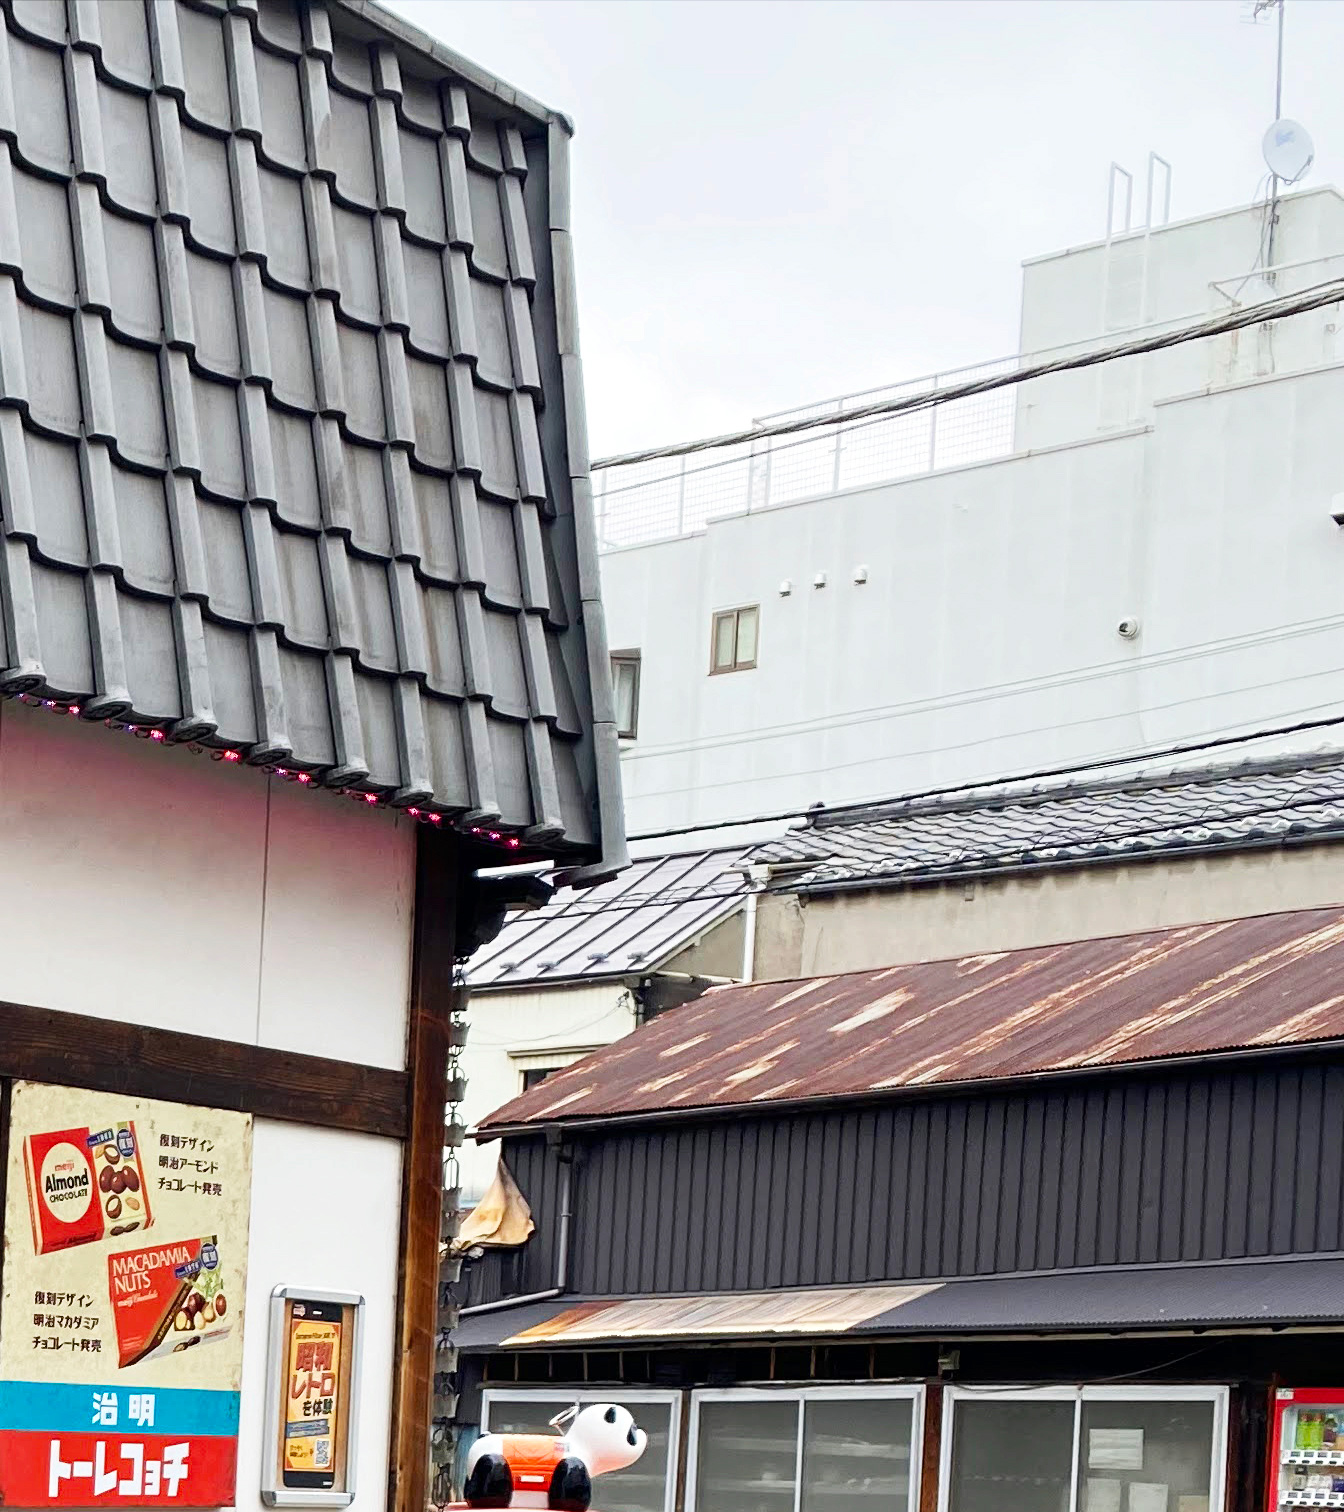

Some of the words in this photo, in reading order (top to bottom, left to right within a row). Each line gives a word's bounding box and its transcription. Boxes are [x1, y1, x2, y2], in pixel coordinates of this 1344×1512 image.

[159, 1155, 218, 1174] 明治アーモンド
[45, 1168, 89, 1193] Almond
[158, 1177, 222, 1196] チョコレート発売
[113, 1246, 192, 1277] MACADAMIA
[114, 1271, 151, 1295] NUTS
[35, 1291, 94, 1307] 復刻デザイン
[33, 1314, 100, 1330] 明治マカダミア
[32, 1336, 102, 1352] チョコレート発売
[291, 1372, 335, 1399] レトロ
